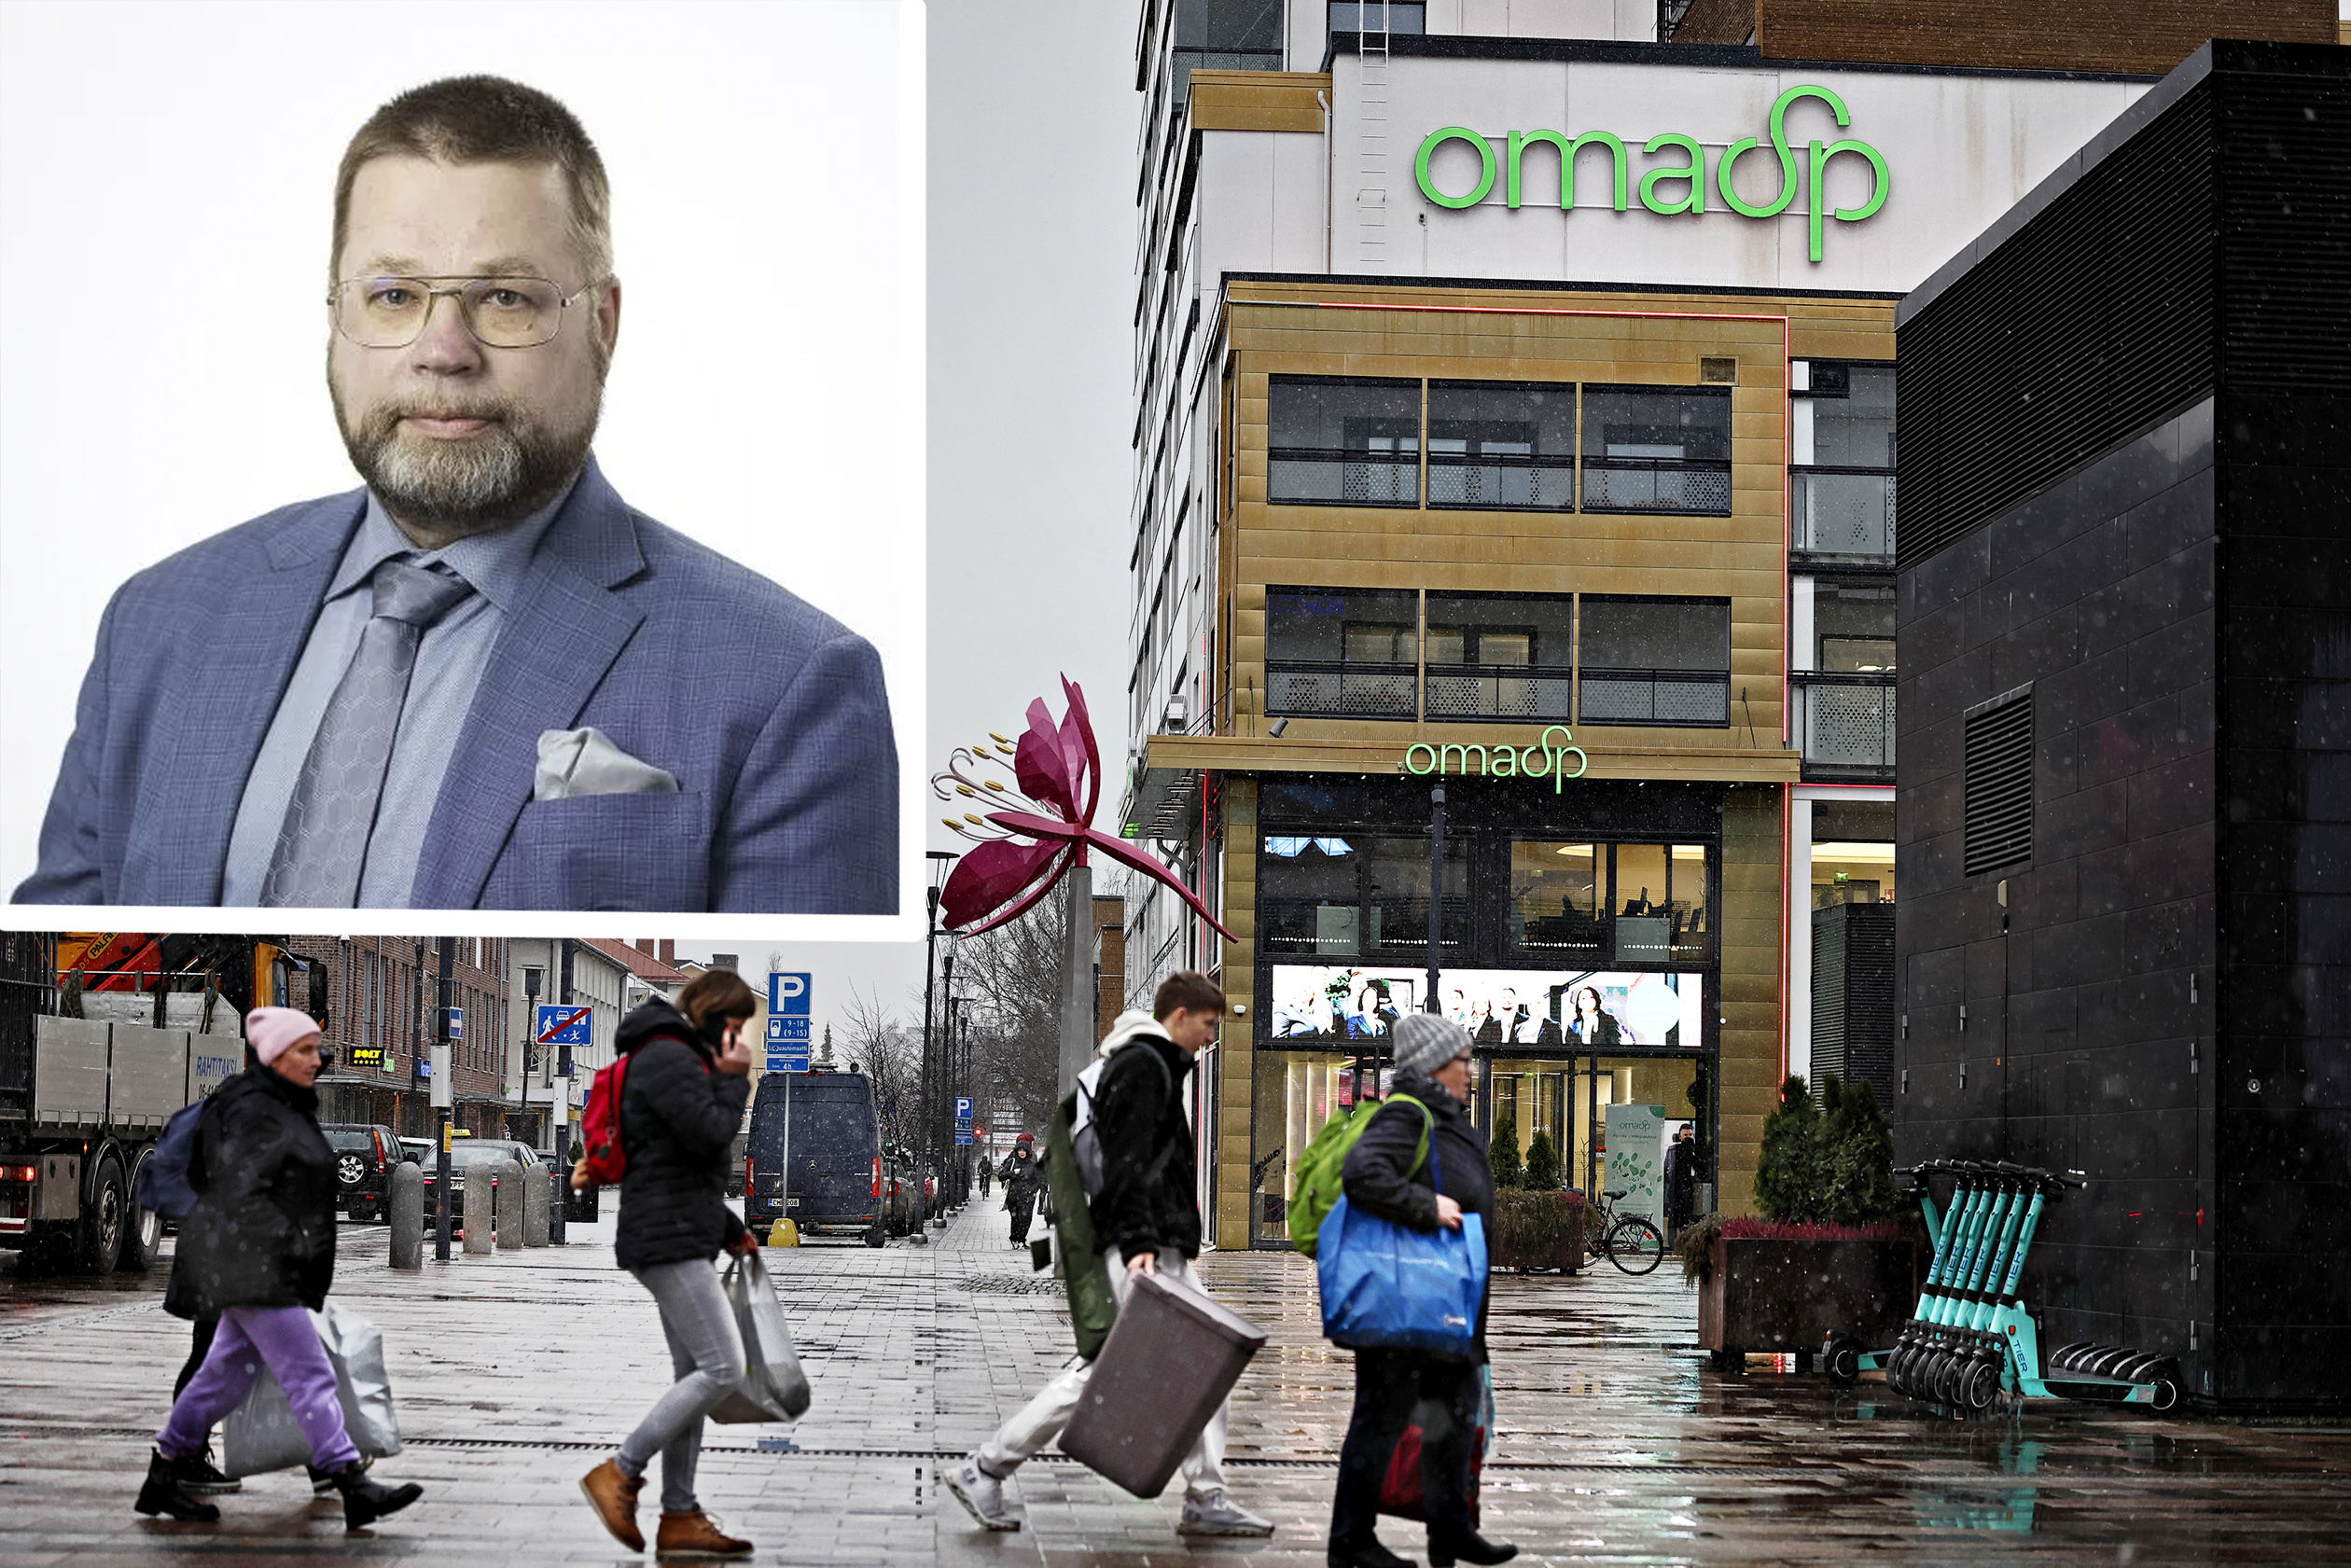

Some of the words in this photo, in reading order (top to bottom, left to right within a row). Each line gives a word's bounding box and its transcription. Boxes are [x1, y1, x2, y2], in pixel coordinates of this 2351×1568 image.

[90, 932, 114, 956] PALFI
[777, 976, 804, 1012] P
[354, 1049, 382, 1058] BOLT
[957, 1099, 969, 1117] P
[2013, 1339, 2028, 1372] TIER
